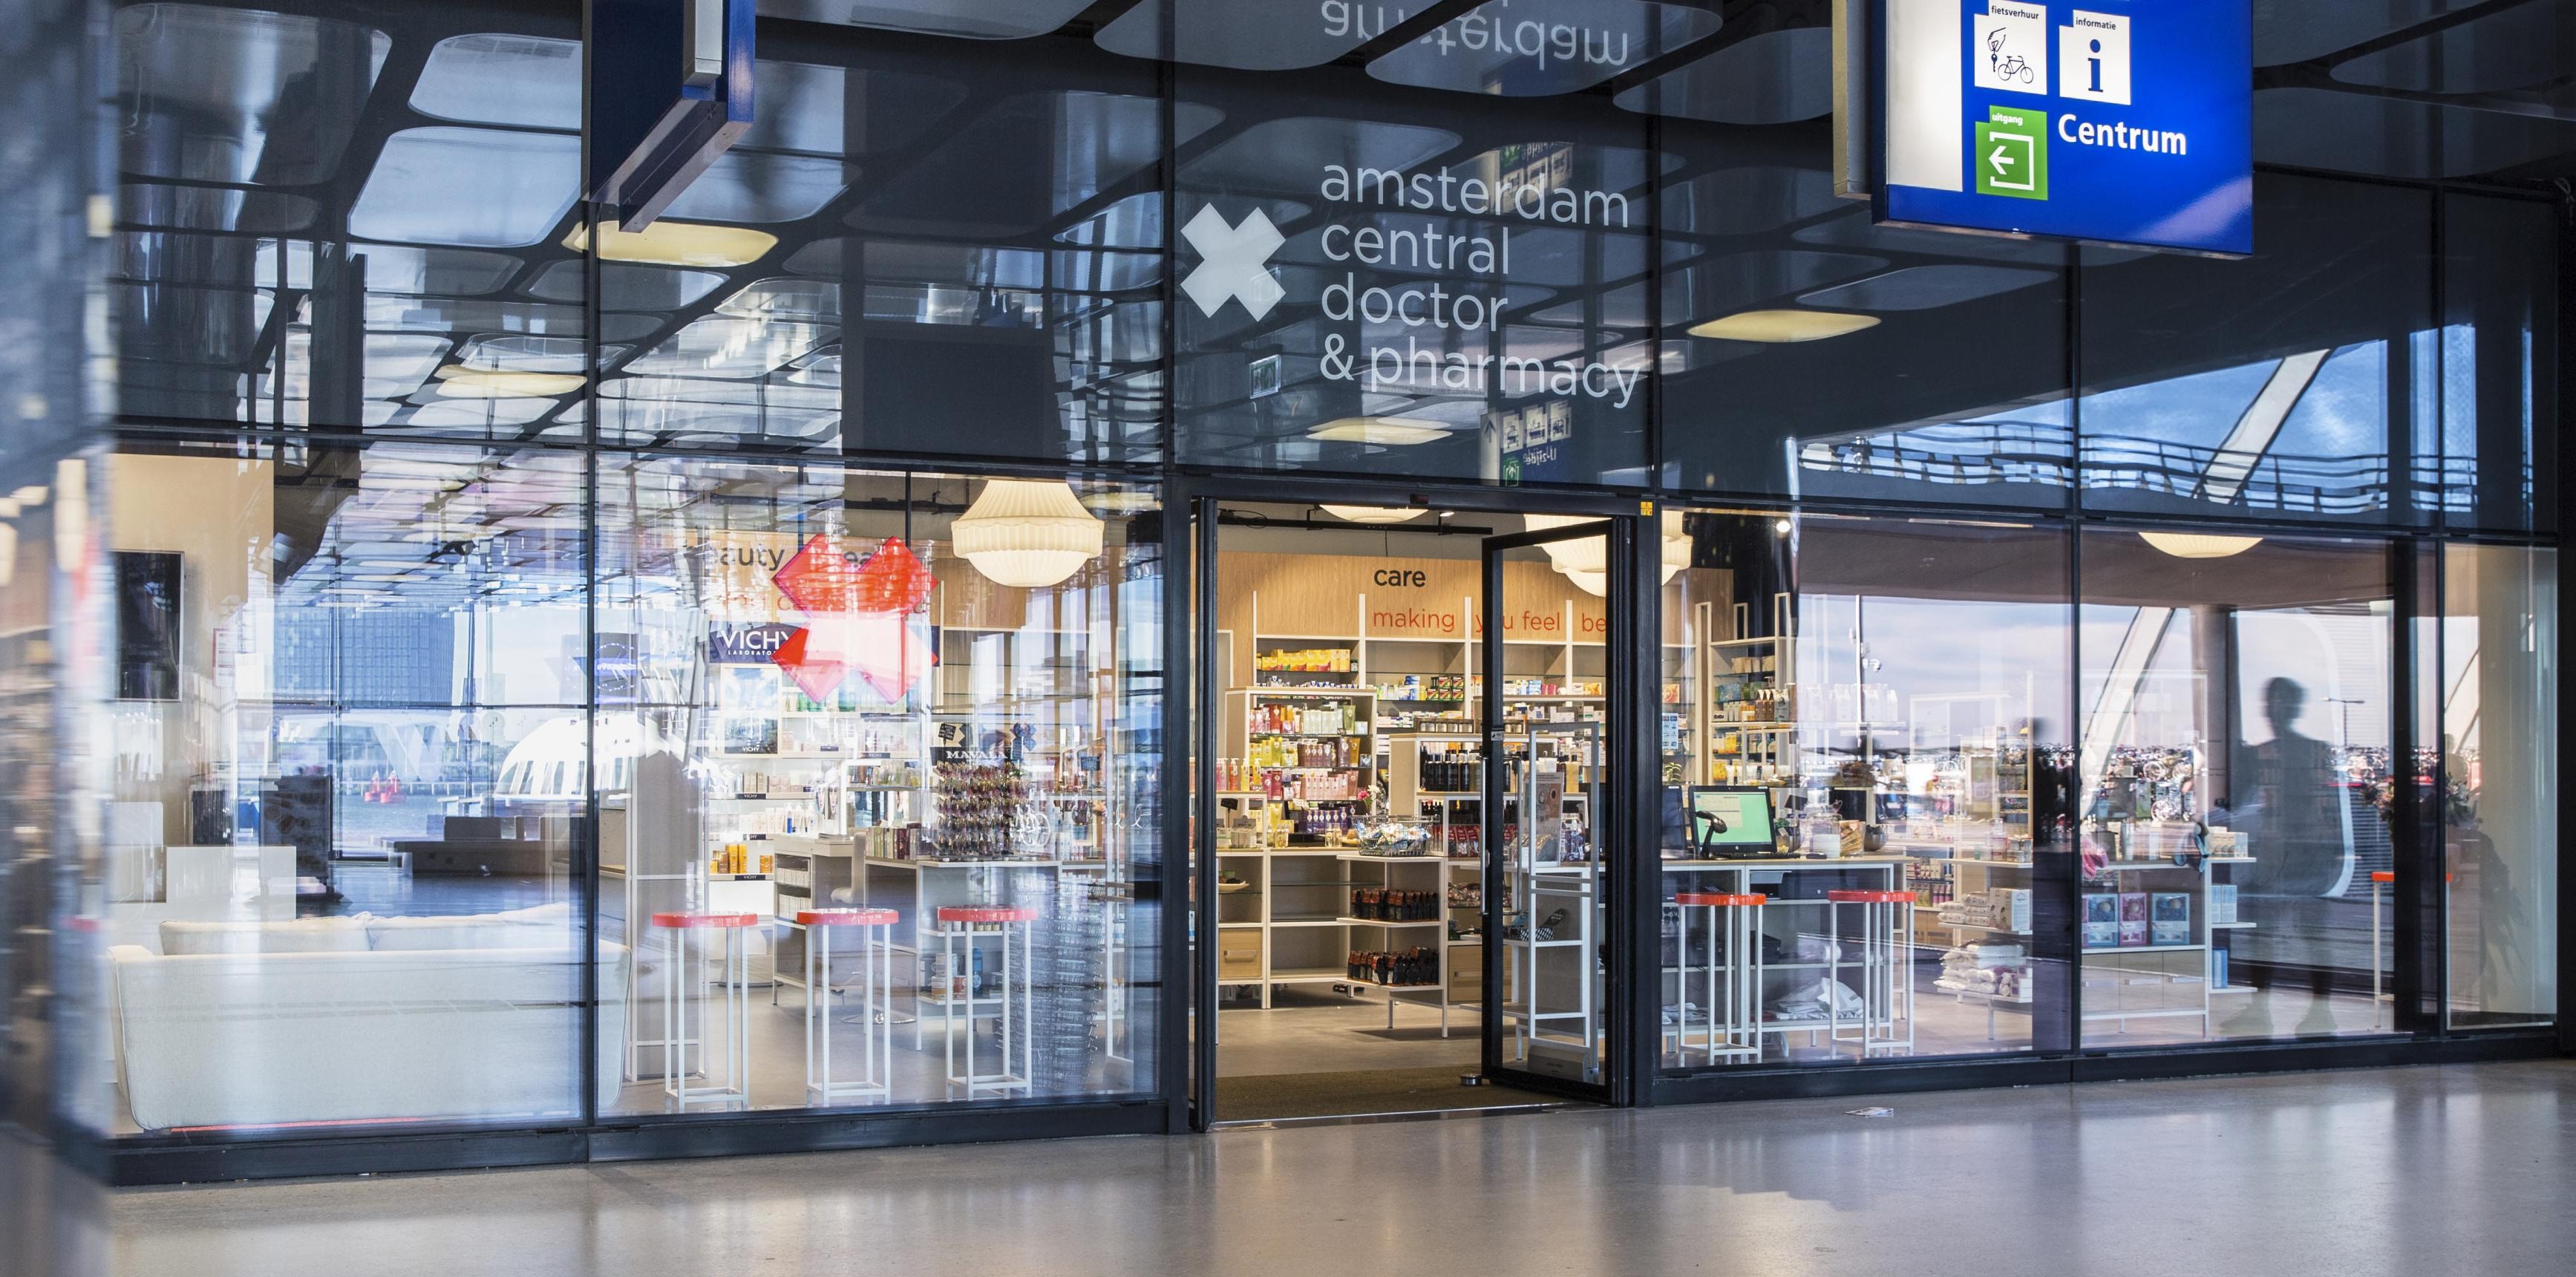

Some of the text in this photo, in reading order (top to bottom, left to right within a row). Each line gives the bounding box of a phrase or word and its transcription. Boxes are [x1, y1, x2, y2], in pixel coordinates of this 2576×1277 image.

[1991, 5, 2039, 20] fietsverhuur
[2076, 17, 2116, 30] informatie
[1991, 112, 2024, 126] uitgang
[2058, 114, 2187, 155] Centrum
[1321, 164, 1629, 228] amsterdam
[1321, 223, 1509, 275] central
[1321, 272, 1508, 332] doctor
[1320, 333, 1641, 408] & pharmacy
[1373, 569, 1426, 588] care
[1373, 608, 1455, 633] making
[1475, 614, 1514, 633] yu
[1522, 610, 1560, 630] feel
